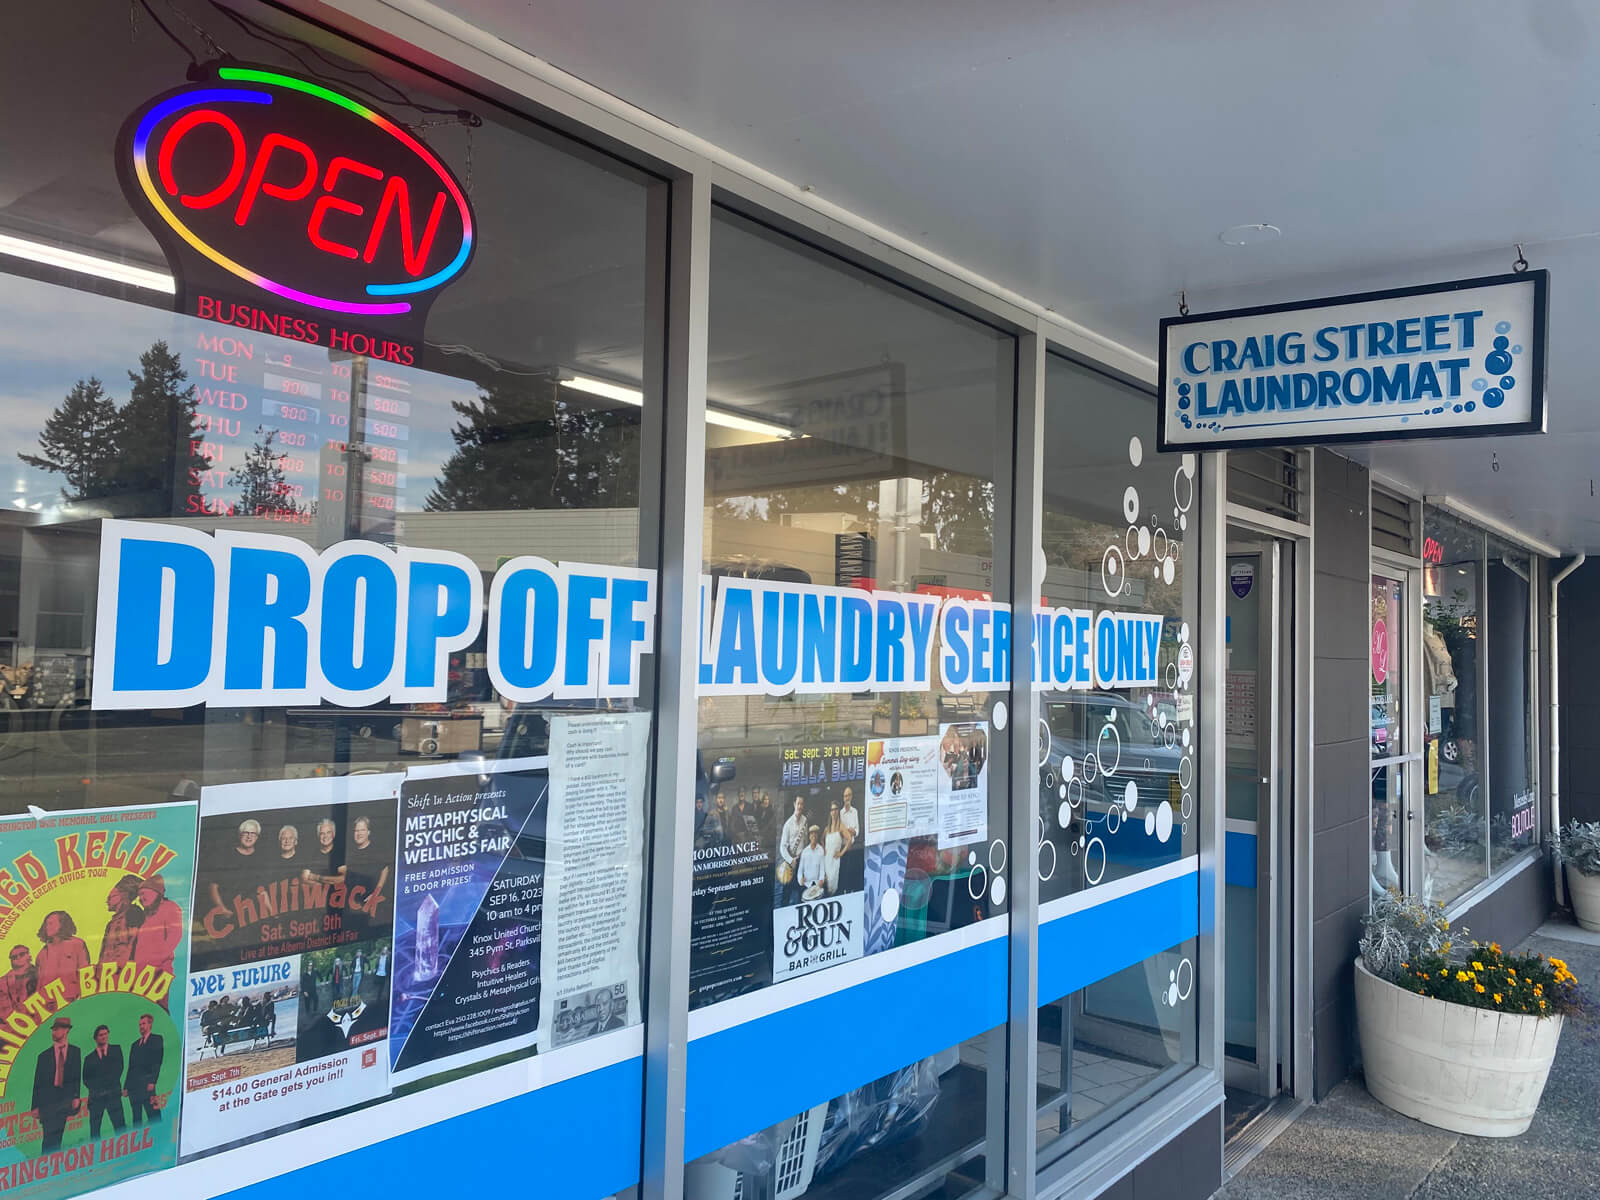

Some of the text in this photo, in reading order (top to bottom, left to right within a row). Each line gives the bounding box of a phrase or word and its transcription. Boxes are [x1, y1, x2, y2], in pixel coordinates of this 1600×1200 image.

[158, 110, 447, 276] OPEN
[197, 295, 414, 366] BUSINESS HOURS
[1183, 310, 1484, 376] CRAIG STREET
[196, 332, 254, 360] MON
[330, 361, 350, 378] TO
[194, 358, 239, 384] TUE
[328, 387, 349, 403] TO
[1194, 358, 1471, 418] LAUNDROMAT
[194, 384, 248, 411] WED
[328, 413, 348, 427] TO
[192, 411, 241, 437] THU
[327, 437, 347, 453] TO
[190, 439, 224, 462] FRI
[325, 463, 345, 478] TO
[187, 466, 229, 490] SAT
[323, 488, 344, 501] TO
[185, 494, 235, 517] SUN
[1423, 536, 1444, 563] OPEN
[112, 537, 471, 692] DROP
[498, 567, 649, 689] OFF
[945, 605, 1090, 685] SERICE
[1098, 616, 1160, 683] ONLY
[823, 747, 832, 757] 30
[835, 747, 840, 757] 9
[782, 759, 827, 787] HELLA
[832, 757, 865, 782] BLUE
[408, 789, 507, 810] Shift In Action presents
[405, 806, 508, 832] METAPHYSICAL
[404, 836, 510, 865] WELLNESS FAIR
[405, 824, 480, 848] PSYCHIC &
[55, 830, 178, 880] KELLY
[405, 863, 475, 882] FREE ADMISSION
[493, 873, 541, 891] SATURDAY
[16, 894, 34, 912] THE
[32, 879, 58, 899] GREAT
[59, 869, 86, 885] DIVIDE
[88, 868, 108, 878] TOUR
[404, 885, 411, 894] &
[413, 881, 439, 893] DOOR
[489, 894, 507, 906] SEP
[521, 888, 543, 900] 2023
[706, 881, 739, 895] September
[486, 910, 496, 921] 10
[498, 909, 512, 919] am
[514, 905, 523, 916] to
[524, 904, 530, 913] 4
[796, 900, 843, 931] ROD
[260, 915, 341, 943] Sat. Sept. 9th
[472, 933, 493, 945] Knox
[493, 928, 519, 941] United
[783, 924, 804, 958] &
[800, 920, 853, 953] GUN
[469, 946, 485, 958] 345
[485, 943, 503, 957] Pym
[788, 947, 847, 971] BAR GRILL
[79, 961, 175, 1002] BROOD
[471, 958, 531, 980] Psychics & Readers
[476, 970, 527, 989] Intuitive Healers
[455, 991, 482, 1005] Crystals
[482, 989, 489, 998] &
[489, 981, 529, 998] Metaphysical
[212, 1056, 349, 1101] $14.00 General Admission
[219, 1100, 230, 1112] at
[233, 1095, 250, 1108] the
[253, 1087, 278, 1102] Gate
[281, 1081, 303, 1097] gets
[305, 1075, 326, 1090] you
[99, 1127, 153, 1164] HALL
